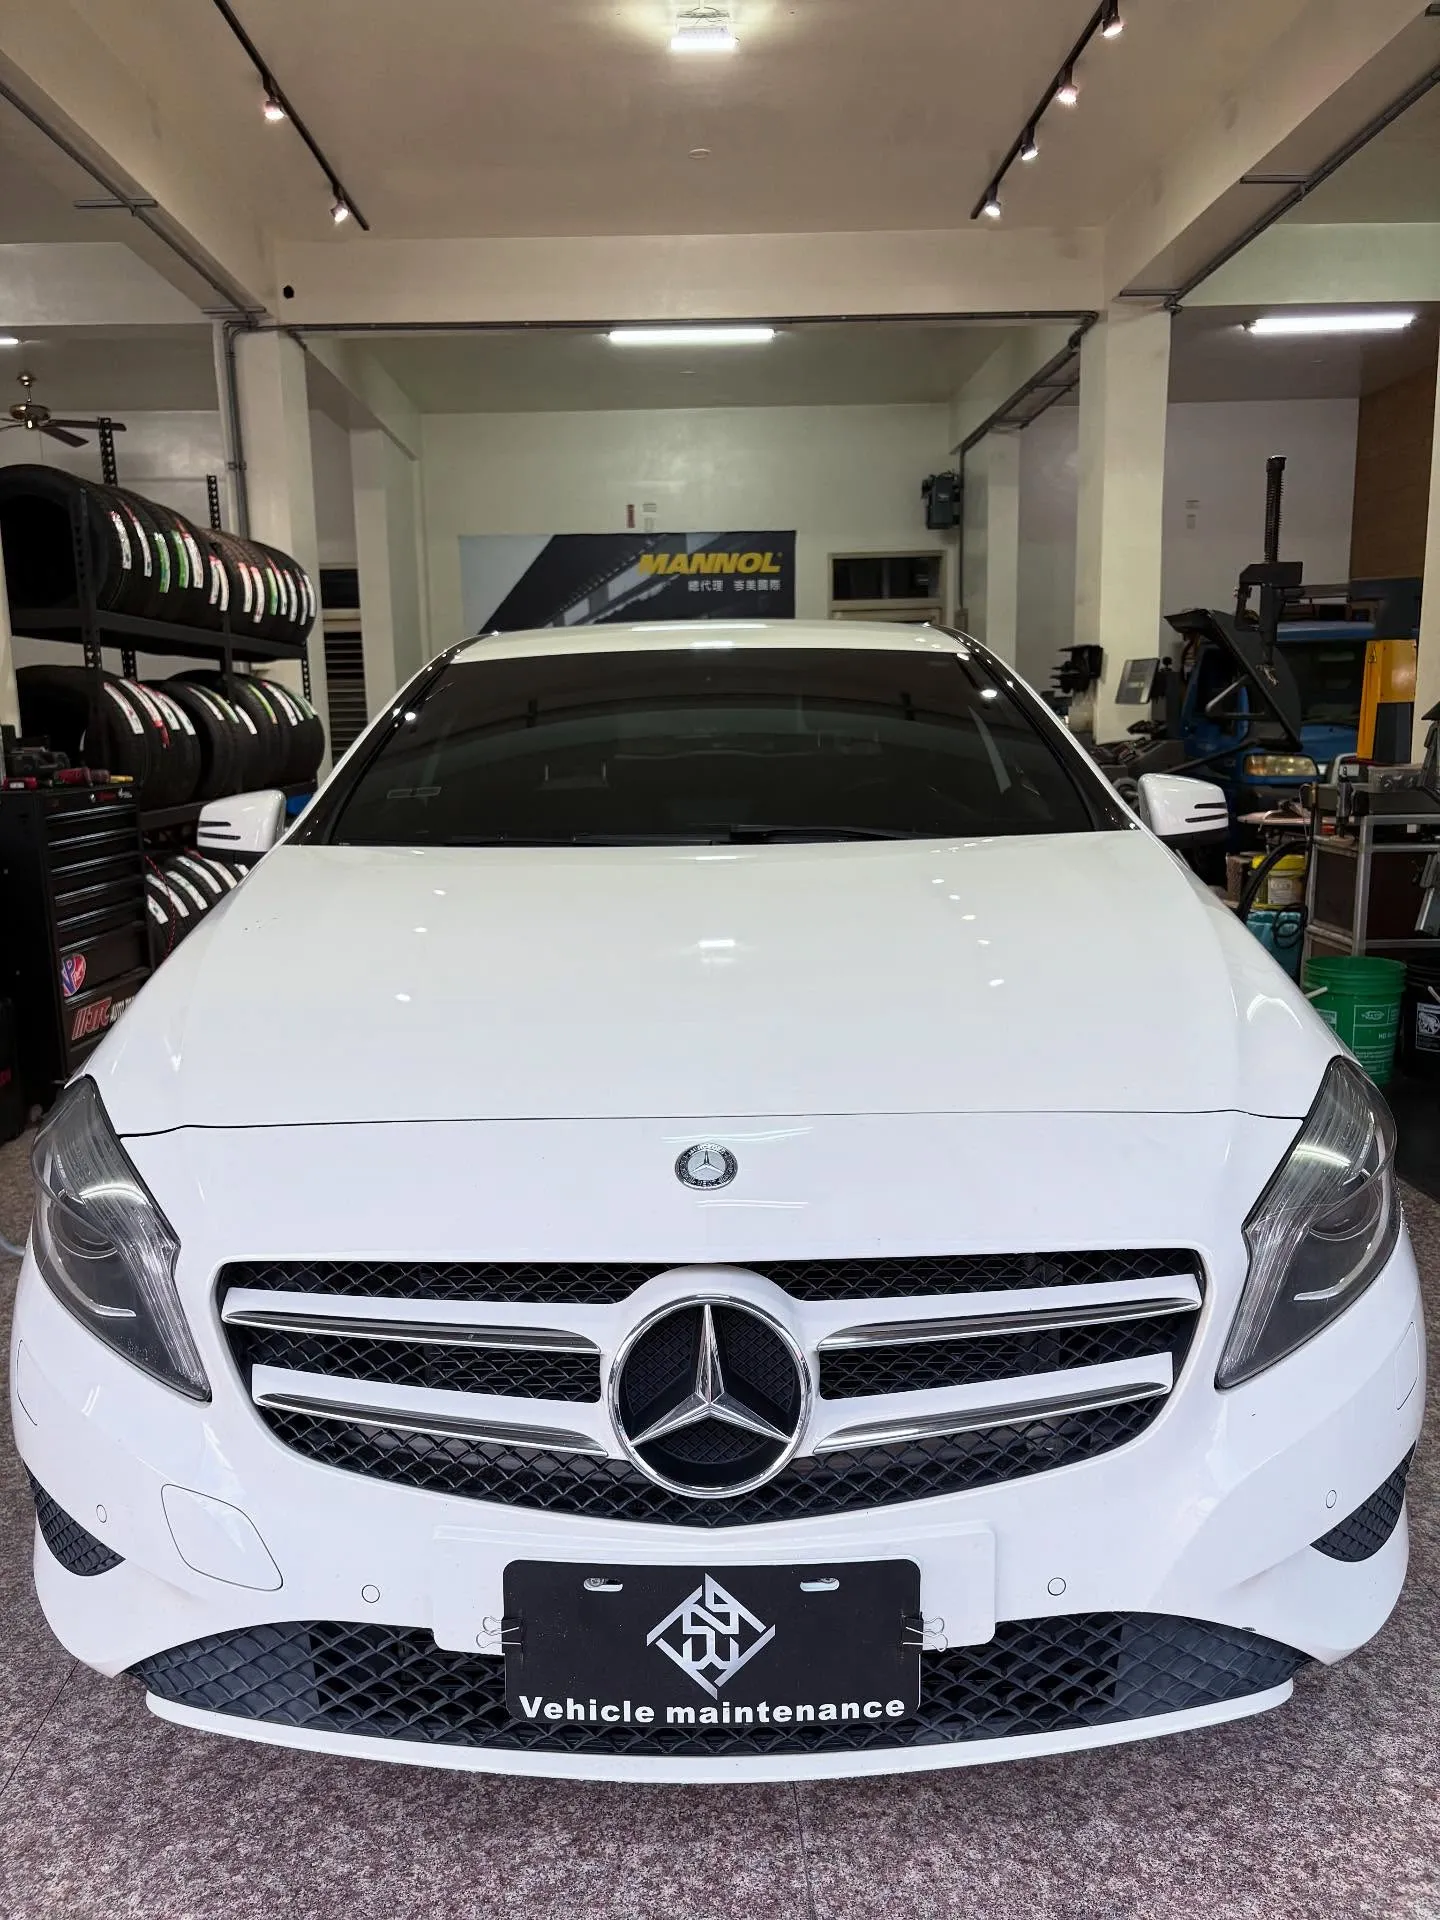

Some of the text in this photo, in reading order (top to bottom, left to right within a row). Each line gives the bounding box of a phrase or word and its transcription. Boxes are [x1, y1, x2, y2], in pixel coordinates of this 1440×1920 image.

[638, 552, 781, 574] MANNOL
[519, 1696, 905, 1723] Vehicle maintenance
